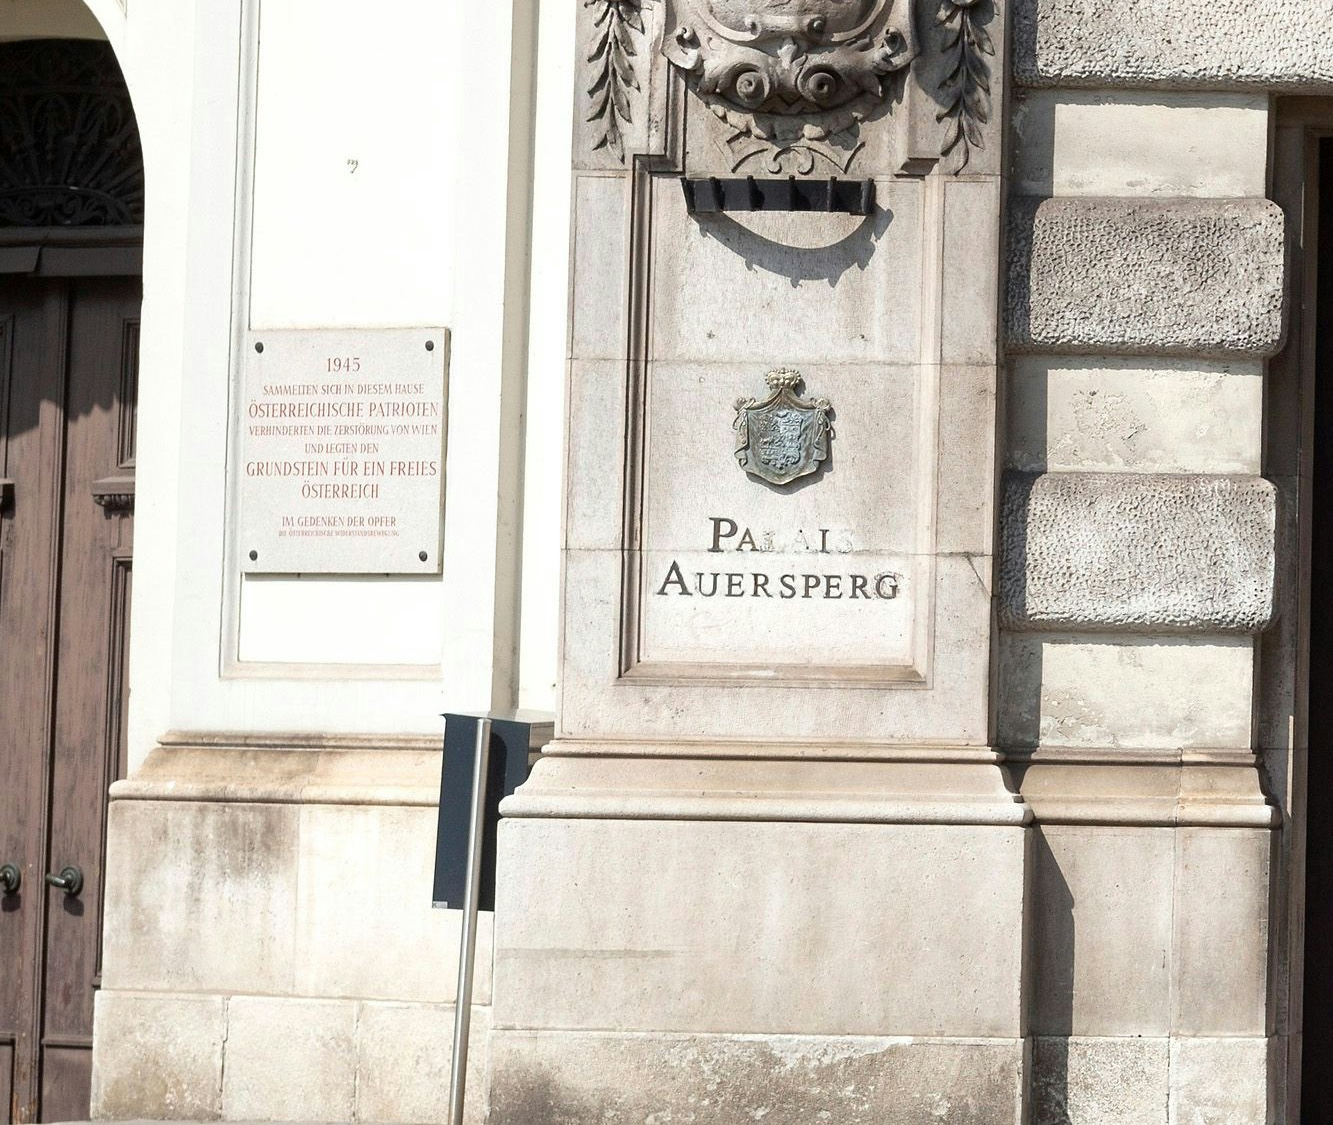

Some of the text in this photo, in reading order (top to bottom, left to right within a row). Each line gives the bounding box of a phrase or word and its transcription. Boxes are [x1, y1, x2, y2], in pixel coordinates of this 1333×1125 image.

[326, 357, 361, 373] 1945
[262, 383, 425, 396] SAMMELTEN SICH IN DIESEM HAUSE
[248, 399, 439, 419] ÖSTERREICHISCHE PATRIOTEN
[249, 422, 438, 437] VERHINDERTEN DIE ZERSTÖRUNG VON WIEN
[304, 442, 379, 455] UND LEGTEN DEN
[245, 457, 438, 477] GRUNDSTEIN FÜR EIN FREIES
[301, 480, 380, 500] ÖSTERREICH
[281, 516, 397, 527] IM GEDENKEN DER OPFER
[655, 559, 900, 600] AUERSPERG
